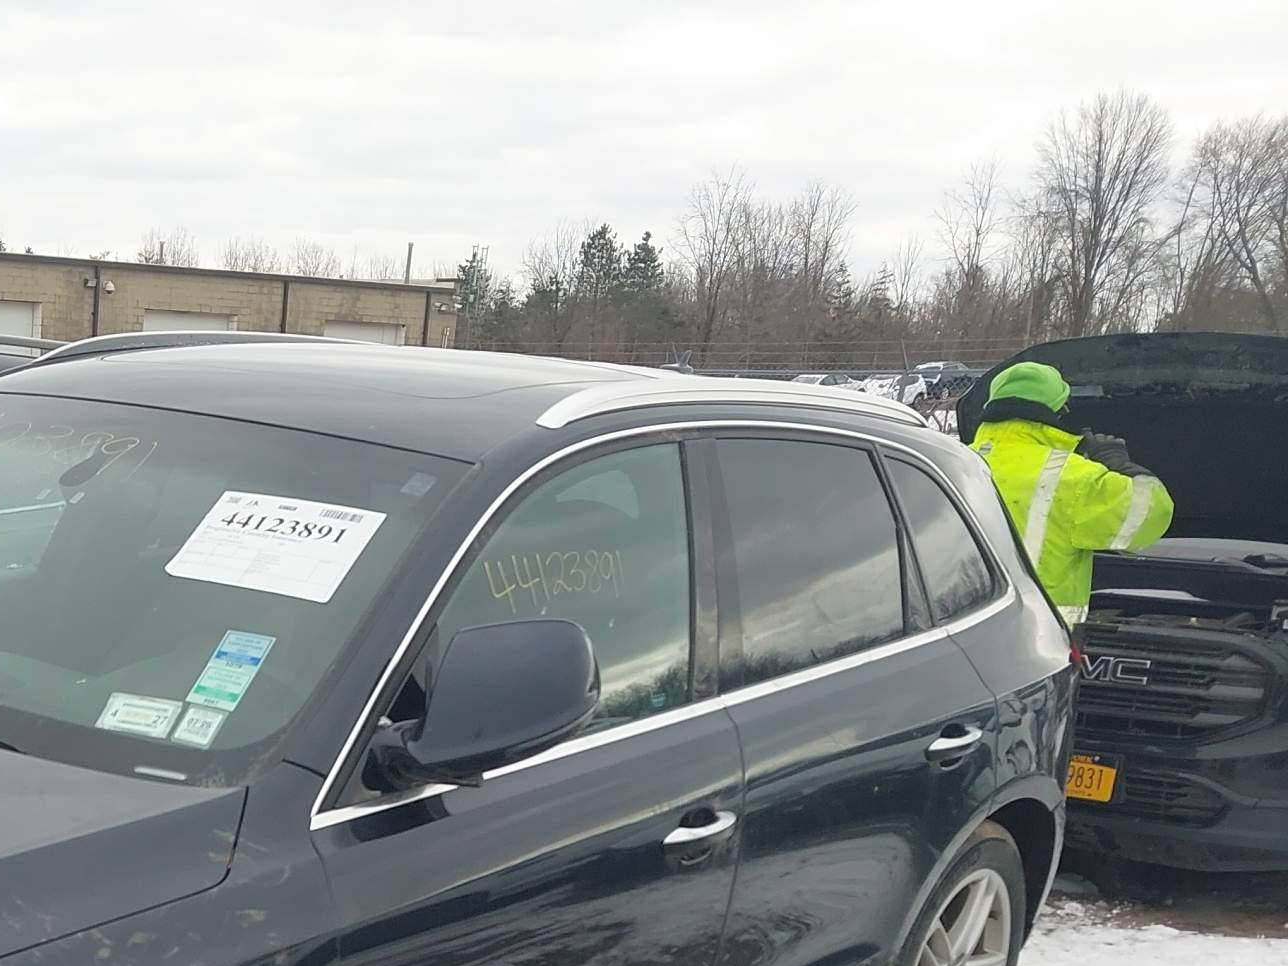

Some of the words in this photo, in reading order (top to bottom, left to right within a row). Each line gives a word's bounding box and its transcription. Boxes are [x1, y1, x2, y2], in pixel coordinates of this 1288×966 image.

[220, 511, 349, 544] 44123891
[483, 550, 625, 614] 44123891
[1079, 654, 1152, 686] MC
